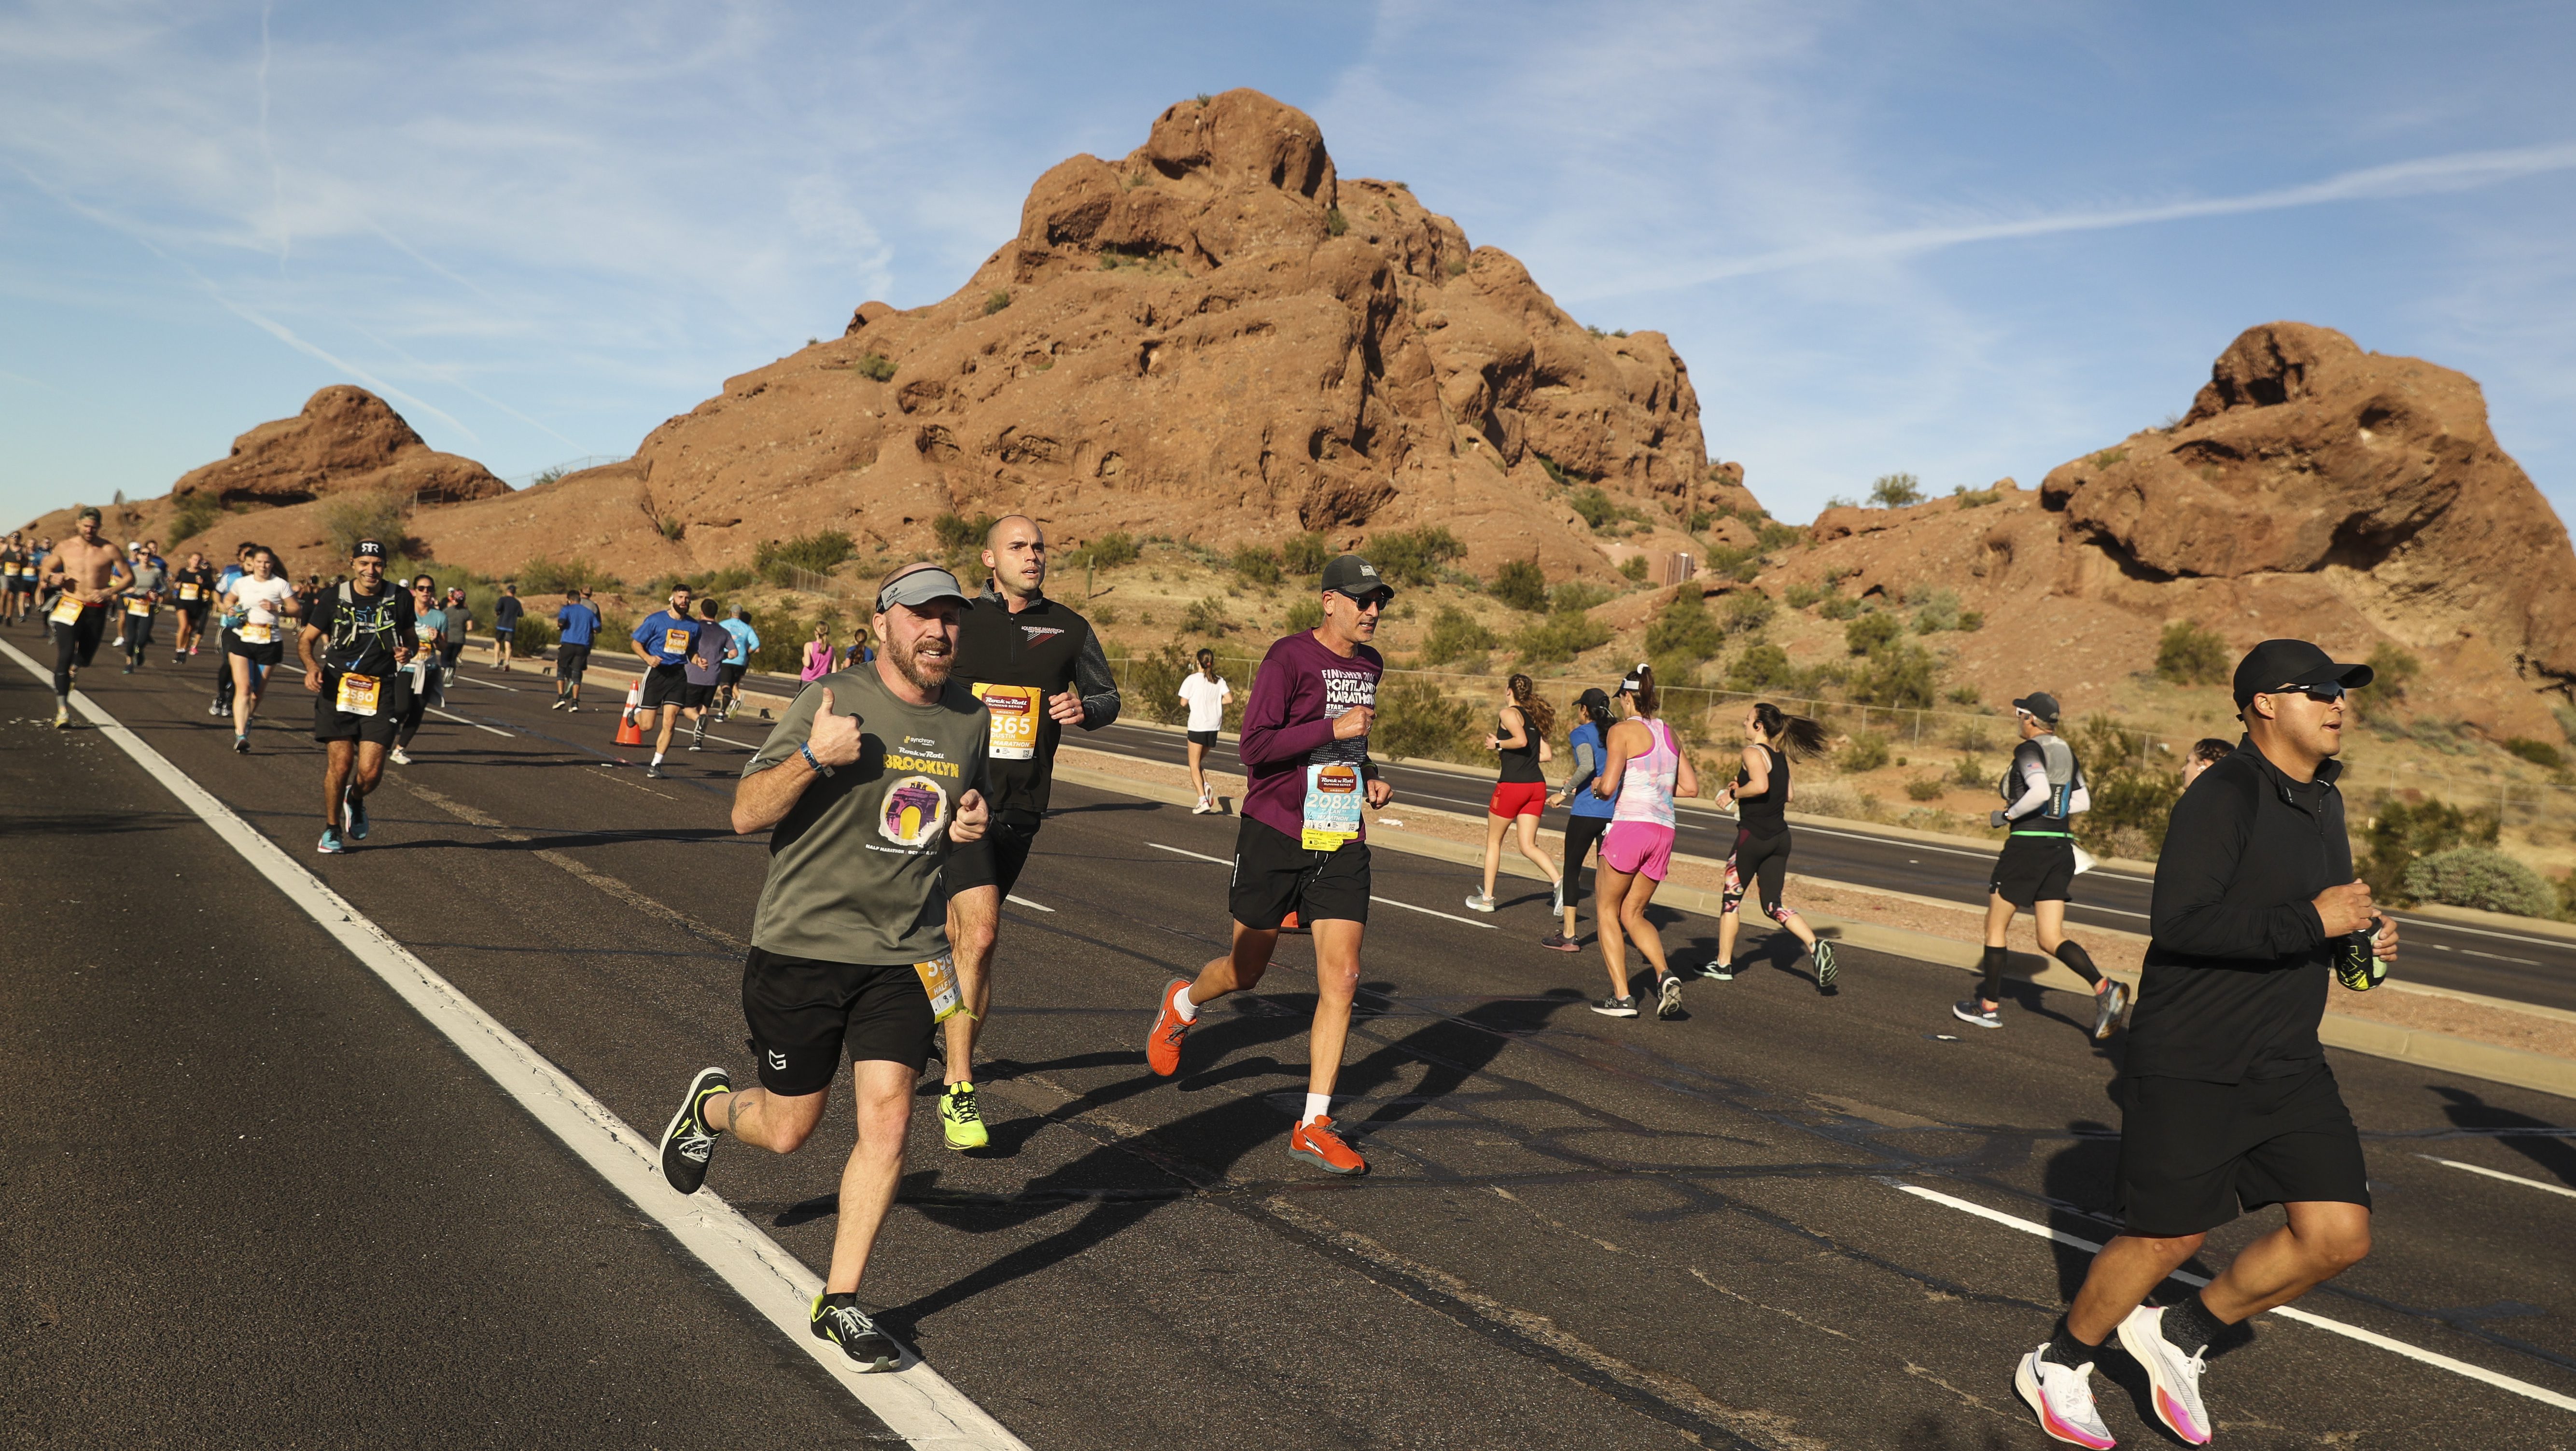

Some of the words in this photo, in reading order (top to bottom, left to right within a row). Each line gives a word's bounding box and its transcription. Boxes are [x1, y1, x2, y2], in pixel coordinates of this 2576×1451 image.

[1321, 669, 1362, 680] FINISHER
[1325, 679, 1375, 693] PORTLAND
[341, 688, 374, 702] 2580
[1326, 690, 1375, 705] MARATHON
[991, 716, 1030, 735] 365
[910, 737, 935, 745] synchrony
[898, 747, 920, 756] Rock
[883, 754, 959, 778] BROOKLYN
[1306, 794, 1360, 809] 20823
[934, 981, 948, 995] HALF
